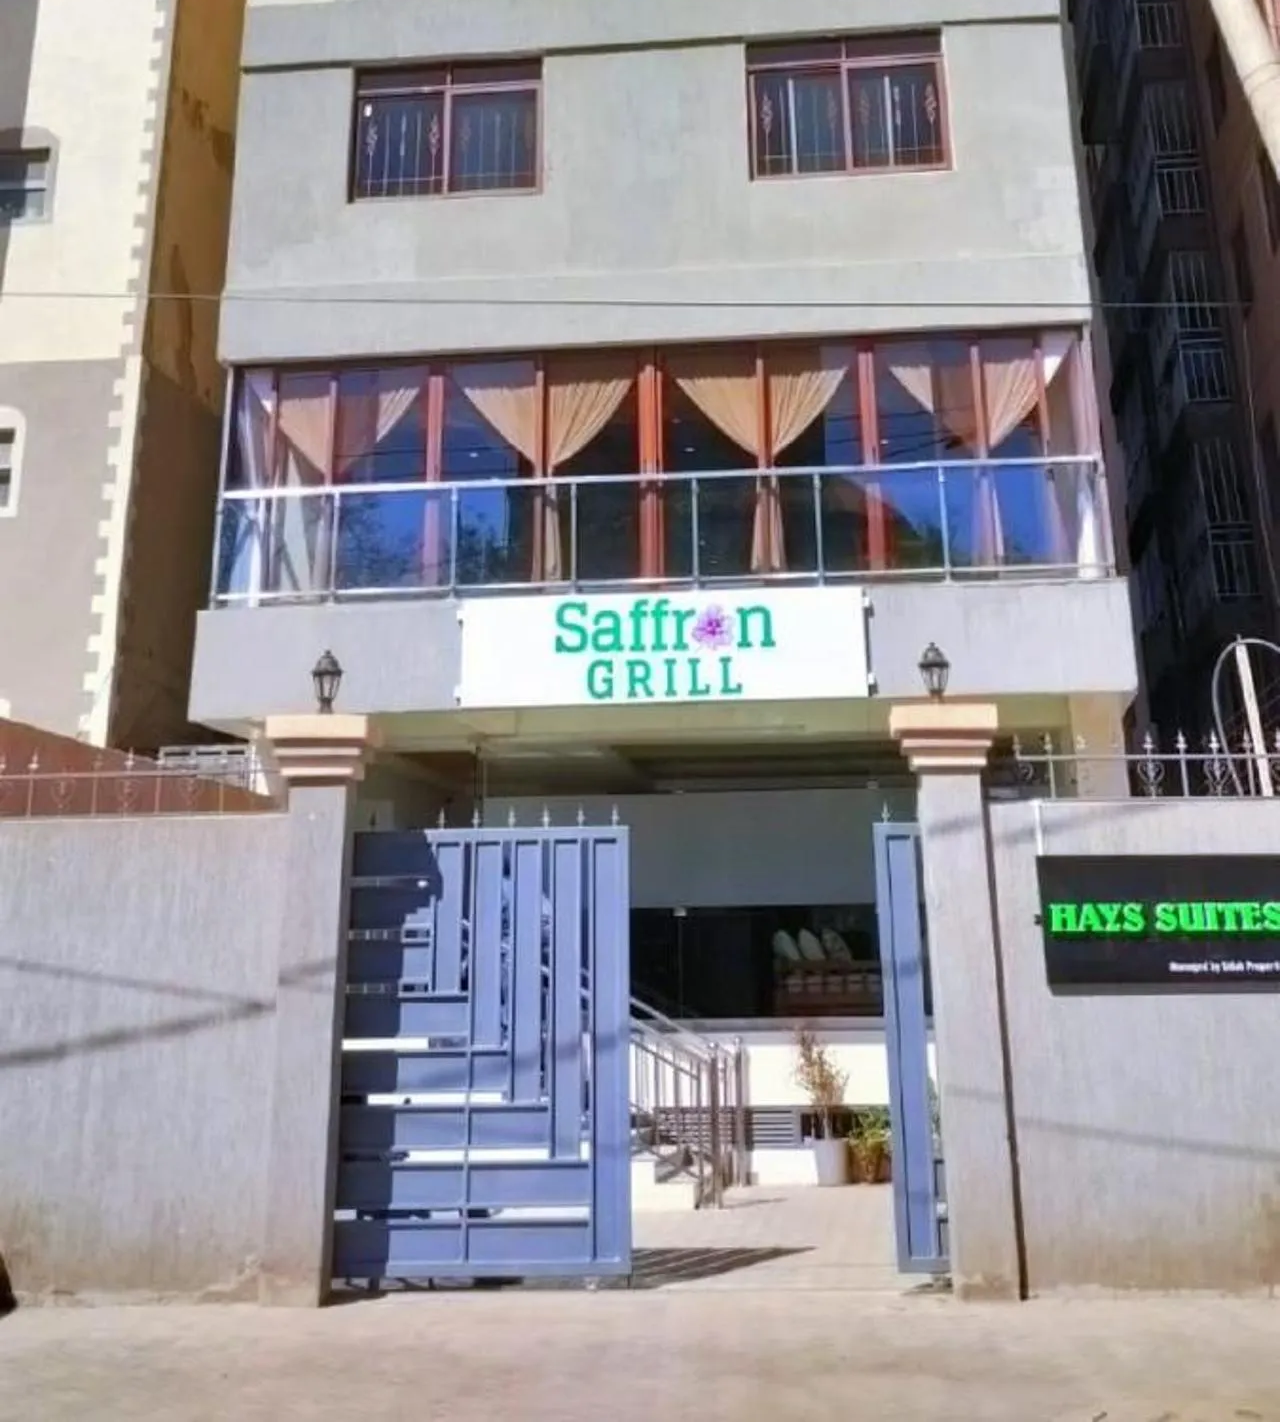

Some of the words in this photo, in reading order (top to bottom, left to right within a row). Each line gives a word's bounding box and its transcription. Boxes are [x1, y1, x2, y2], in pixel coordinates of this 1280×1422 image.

[554, 599, 776, 654] Saffrn
[587, 656, 743, 699] GRILL
[1049, 903, 1145, 932] HAYS
[1155, 902, 1280, 932] SUITES
[1169, 961, 1208, 973] Managed
[1210, 960, 1220, 974] by
